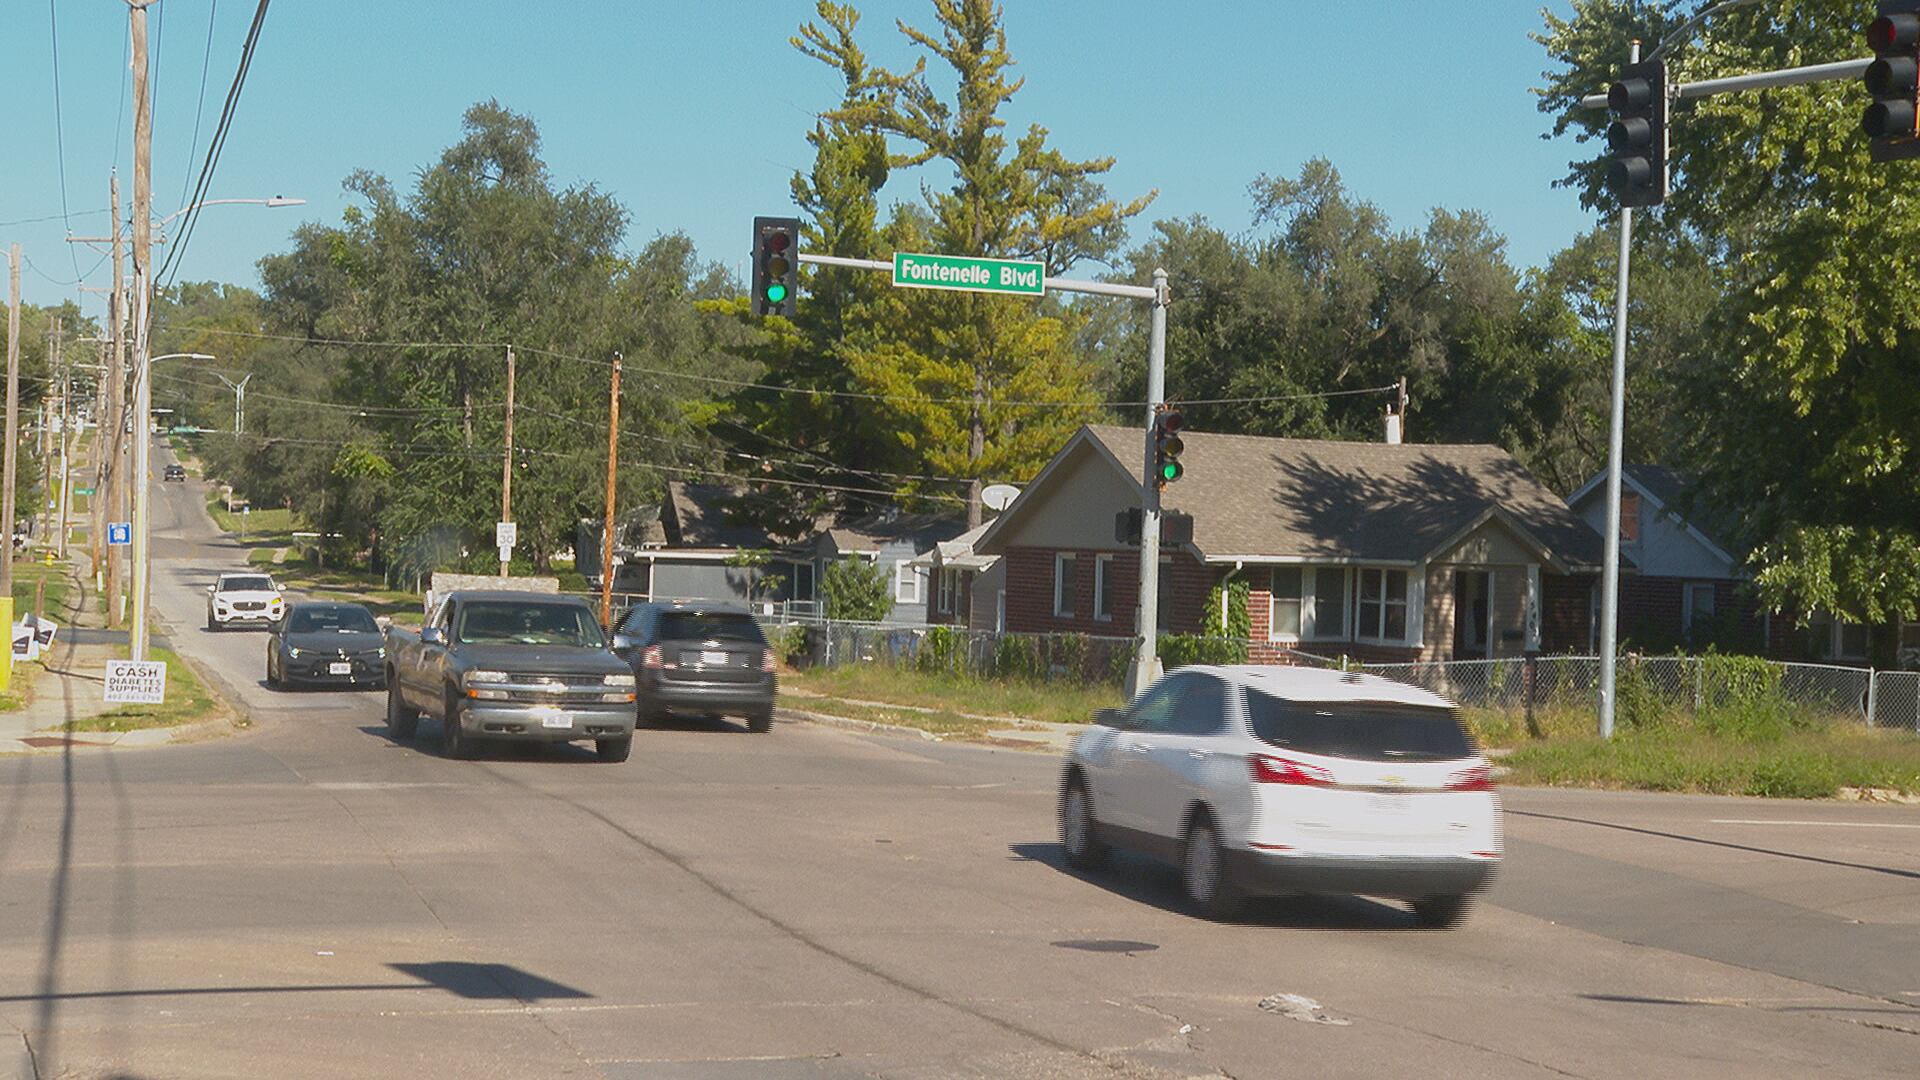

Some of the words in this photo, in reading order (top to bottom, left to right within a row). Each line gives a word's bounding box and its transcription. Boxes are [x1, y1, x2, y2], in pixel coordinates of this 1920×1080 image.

[902, 259, 990, 284] Fontenelle
[500, 535, 514, 544] 30
[115, 667, 157, 677] CASH
[109, 677, 161, 686] DIABETES
[108, 685, 161, 693] SUPPLIES
